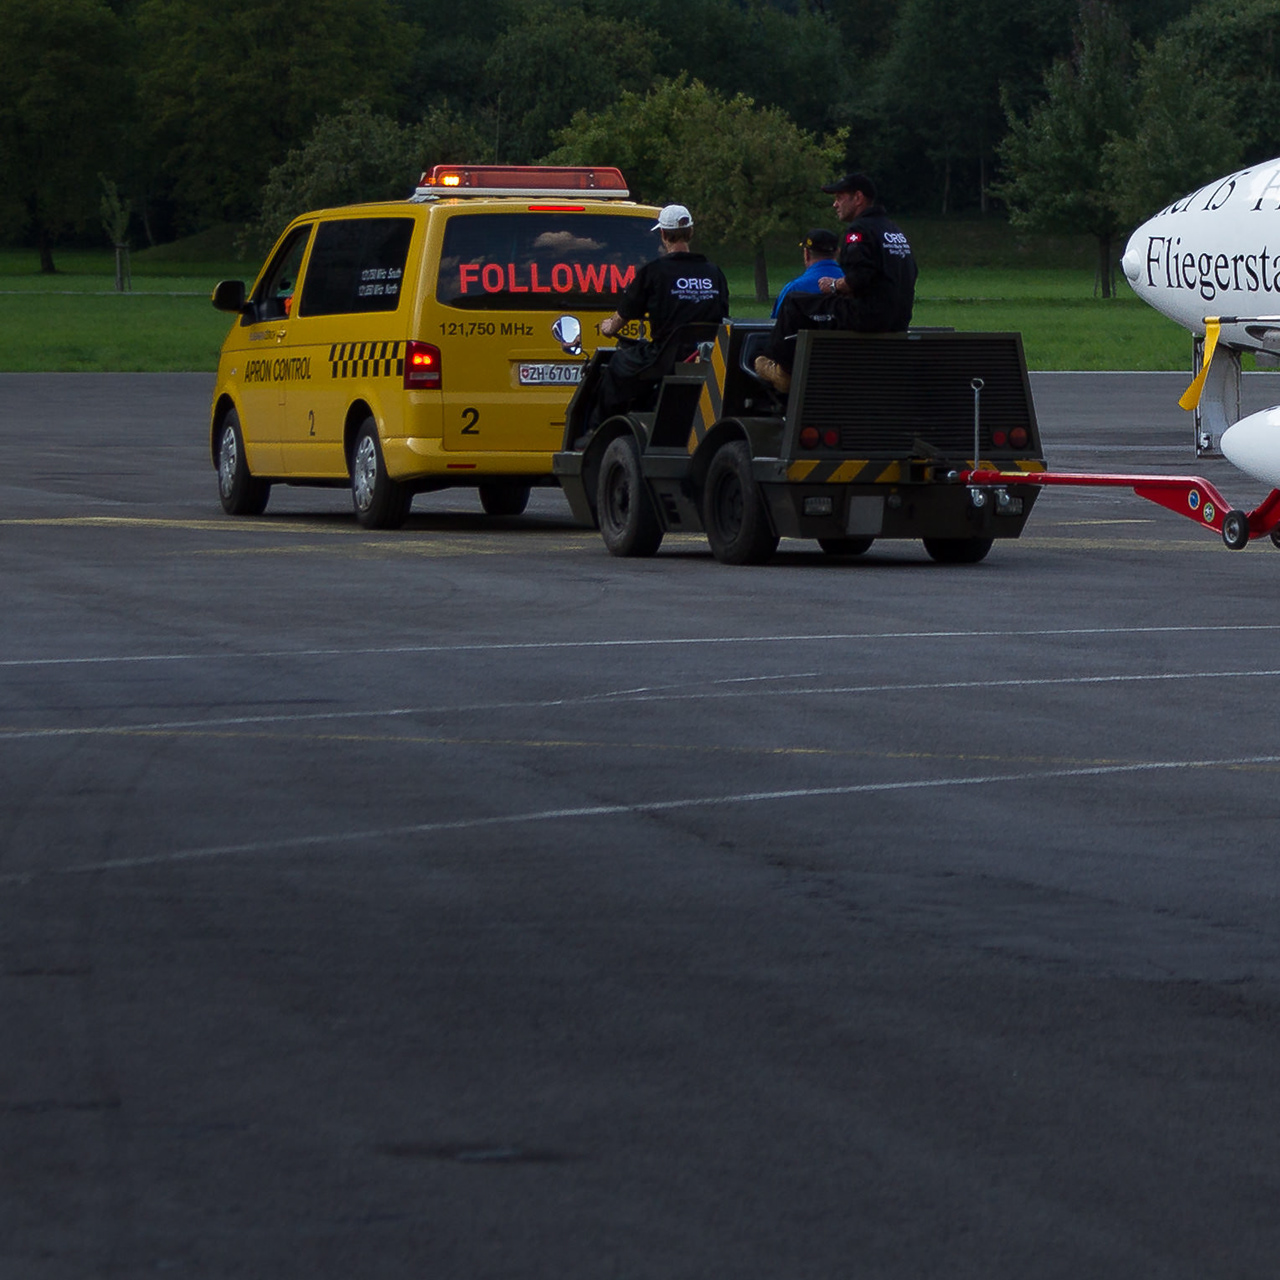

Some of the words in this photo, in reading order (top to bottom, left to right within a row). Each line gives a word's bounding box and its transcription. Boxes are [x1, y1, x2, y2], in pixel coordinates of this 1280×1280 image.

[1201, 170, 1252, 211] 15
[676, 277, 713, 290] ORIS
[438, 322, 496, 337] 121,750
[500, 323, 534, 336] MHz
[244, 359, 272, 383] APRON
[272, 357, 312, 382] CONTROL
[308, 410, 316, 437] 2
[461, 407, 480, 435] 2
